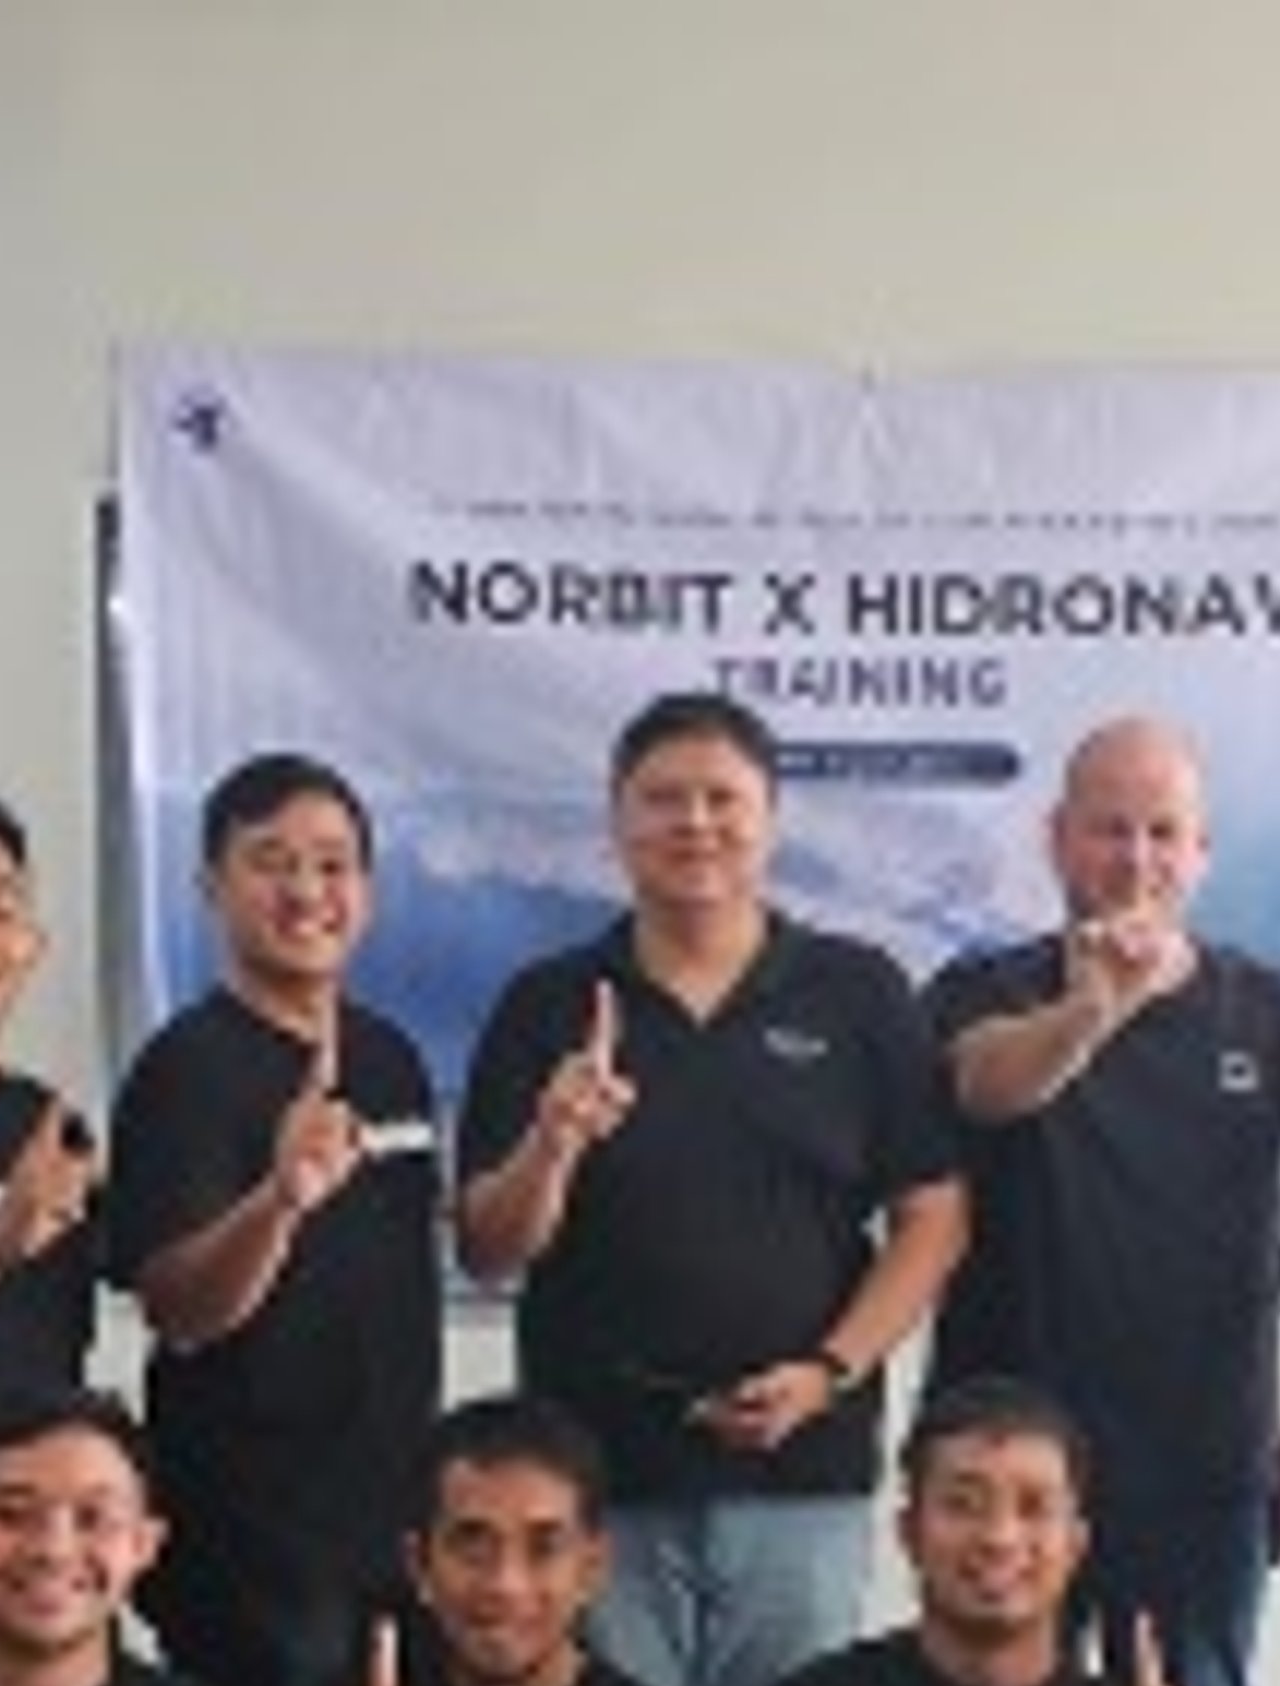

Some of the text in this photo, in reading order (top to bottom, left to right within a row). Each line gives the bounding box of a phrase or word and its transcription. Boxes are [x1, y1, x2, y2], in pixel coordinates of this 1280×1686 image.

[411, 560, 733, 634] NORBIT
[763, 572, 816, 635] X
[714, 656, 1008, 707] TRAINING
